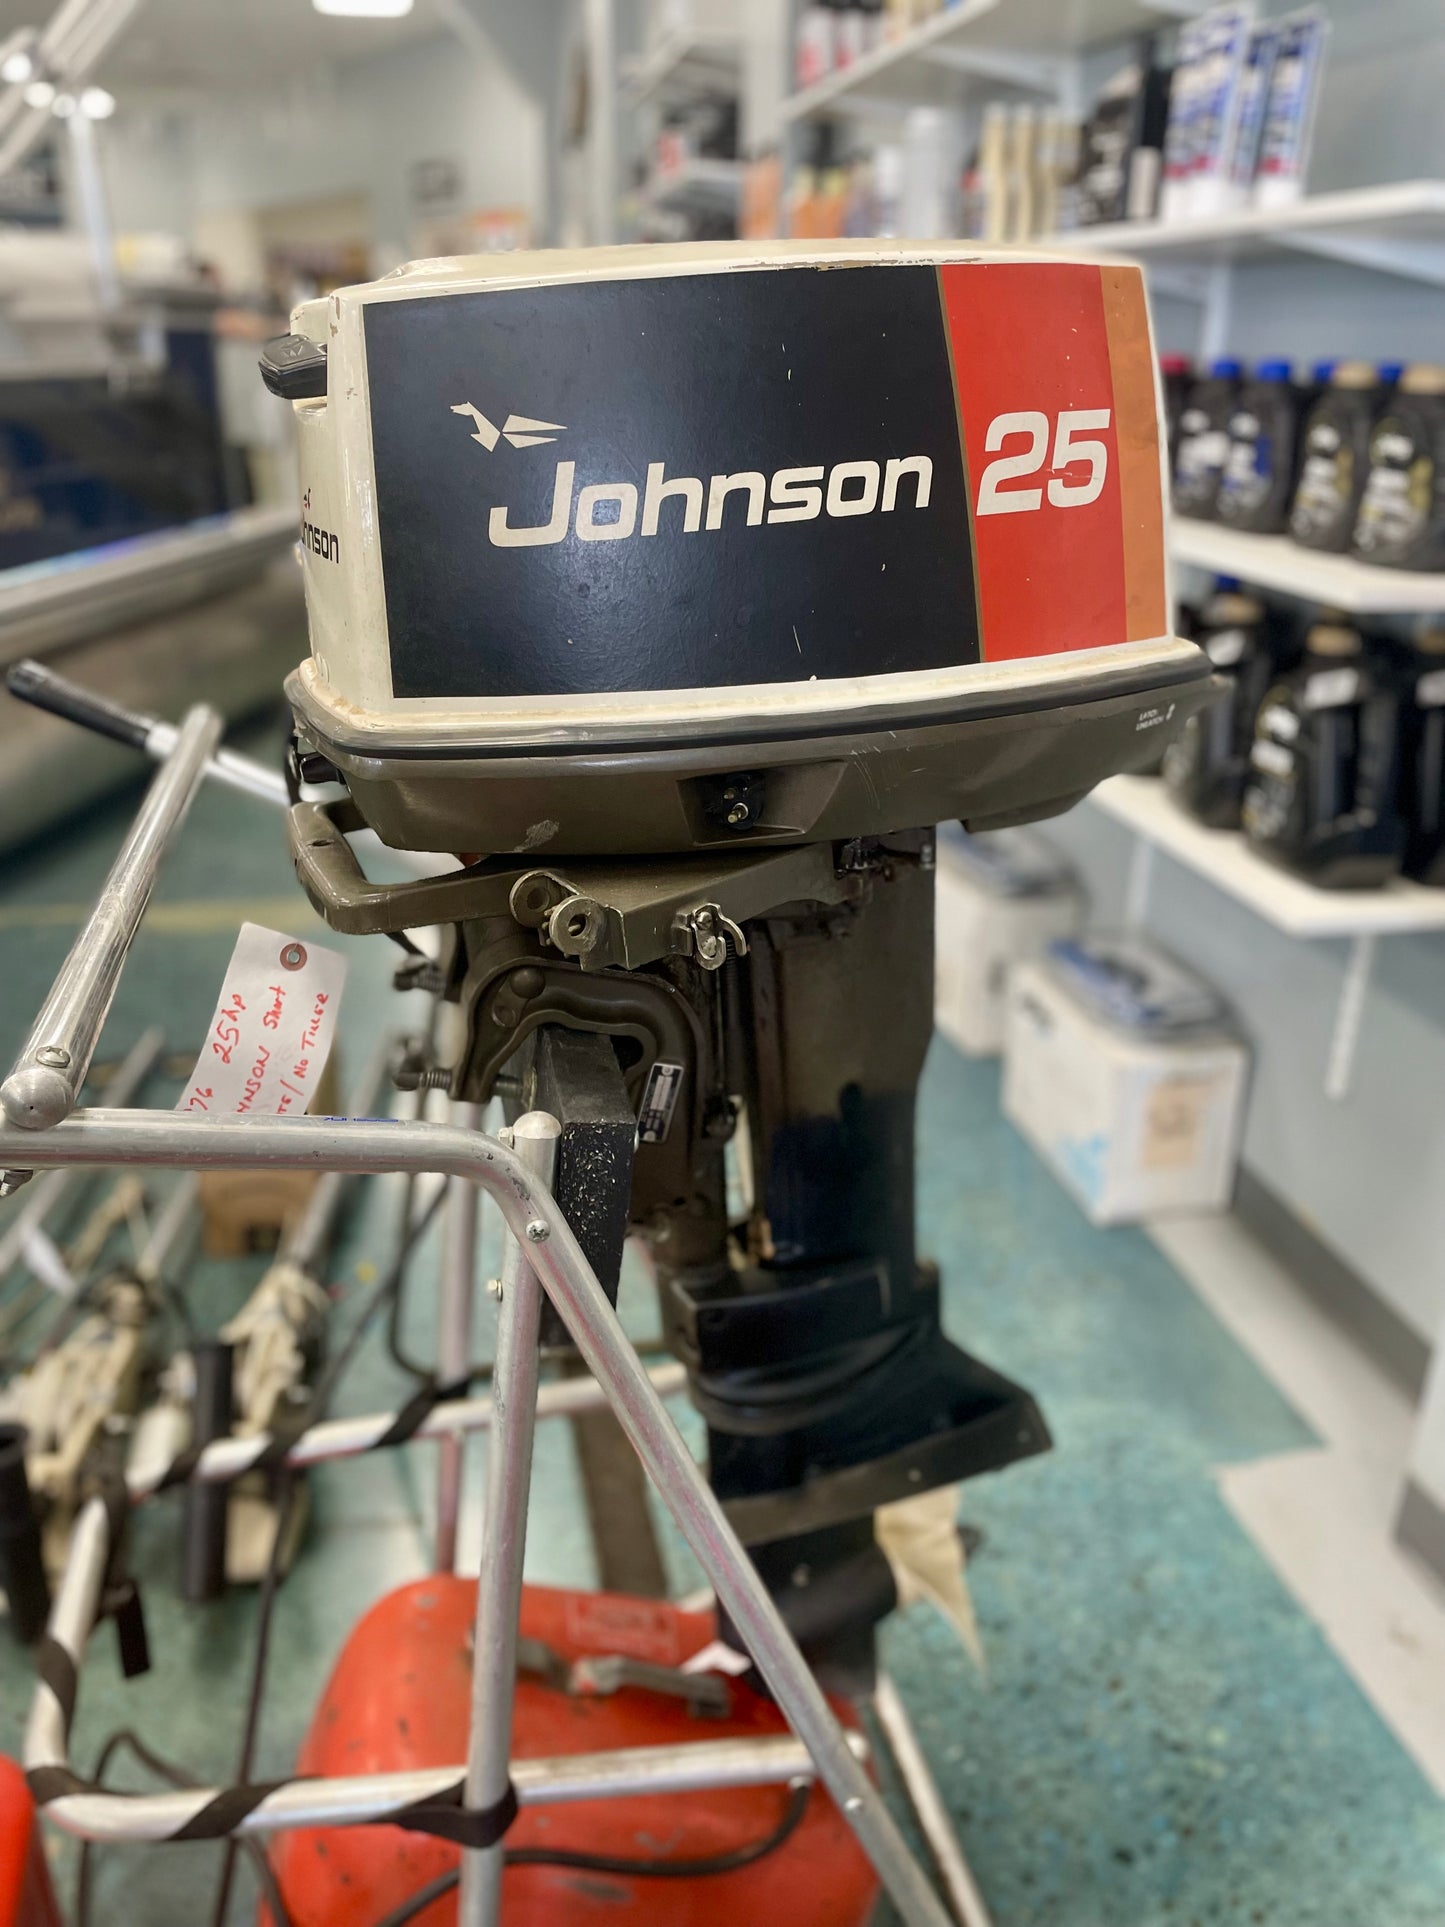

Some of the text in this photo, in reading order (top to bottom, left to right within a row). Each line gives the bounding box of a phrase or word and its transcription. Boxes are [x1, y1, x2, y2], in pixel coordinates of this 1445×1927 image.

[487, 454, 934, 548] Johnson
[976, 408, 1112, 517] 25
[236, 1044, 271, 1114] HNSON
